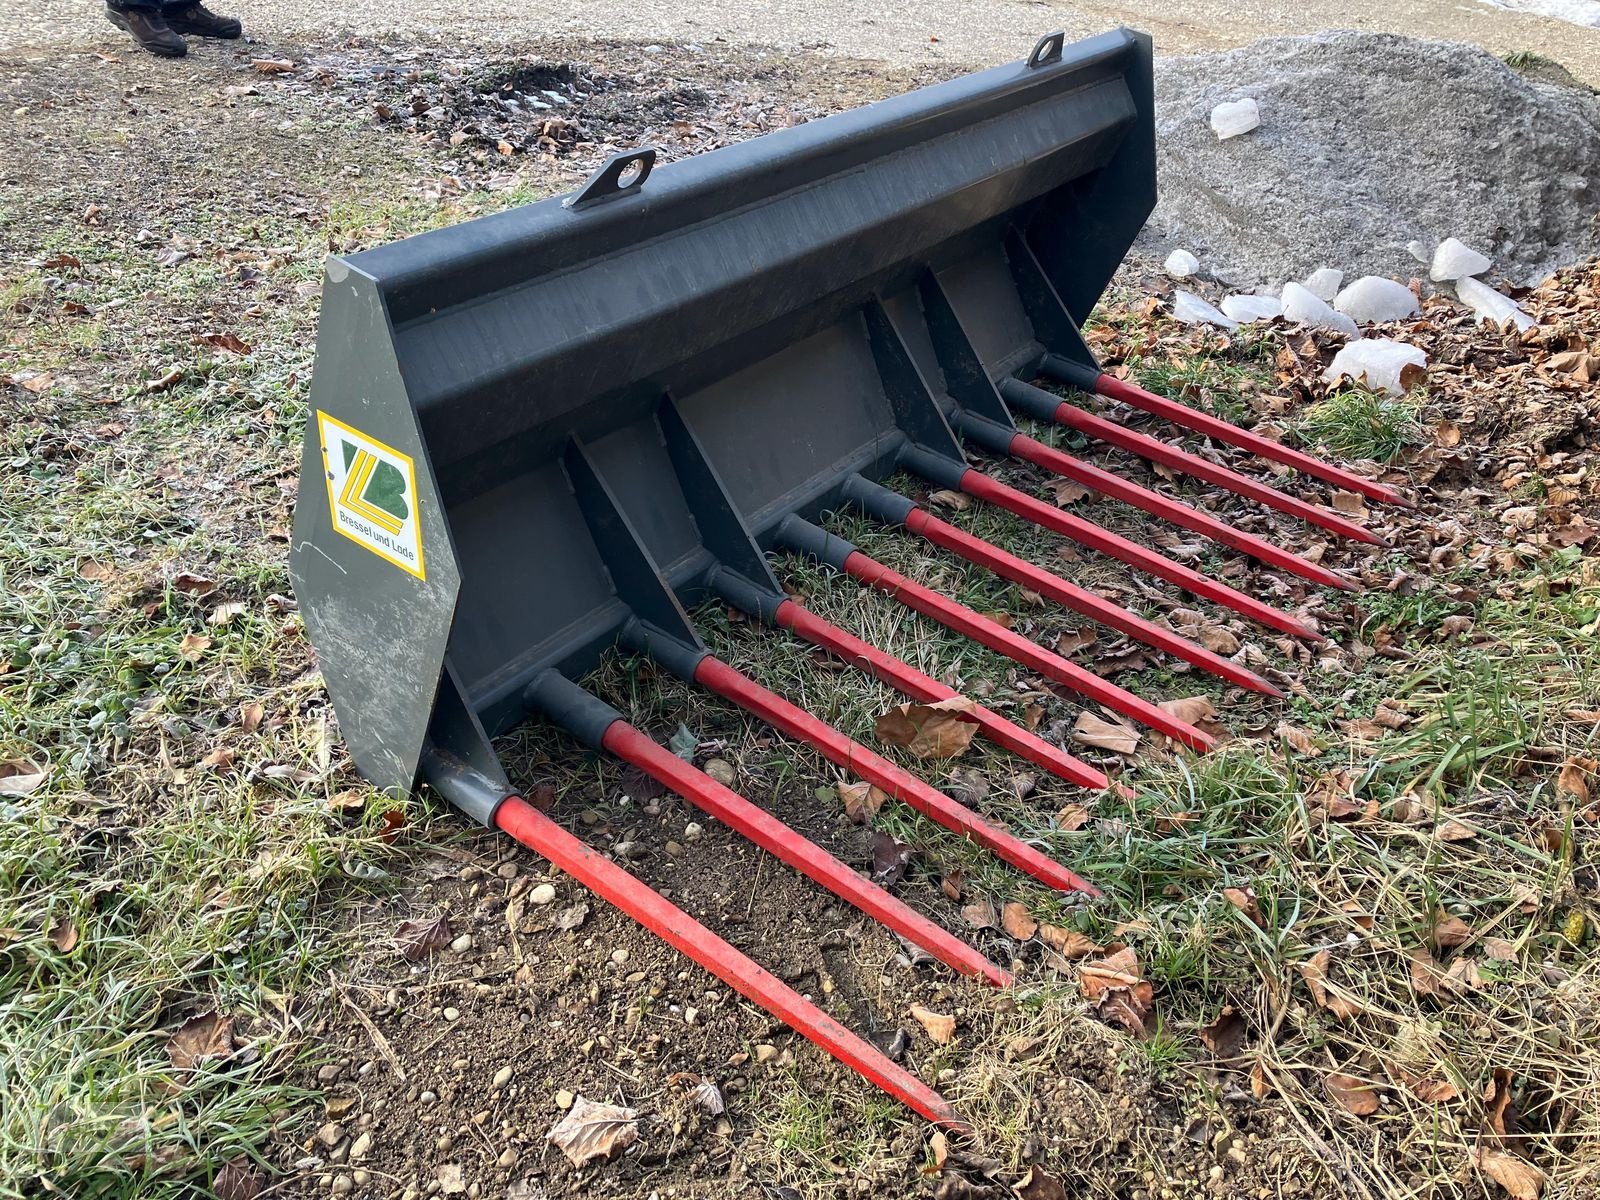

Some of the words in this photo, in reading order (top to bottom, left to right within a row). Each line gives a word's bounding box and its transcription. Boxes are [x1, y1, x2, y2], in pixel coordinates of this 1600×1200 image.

[339, 510, 372, 537] Bressel
[373, 531, 390, 547] und
[391, 539, 414, 561] Lade
